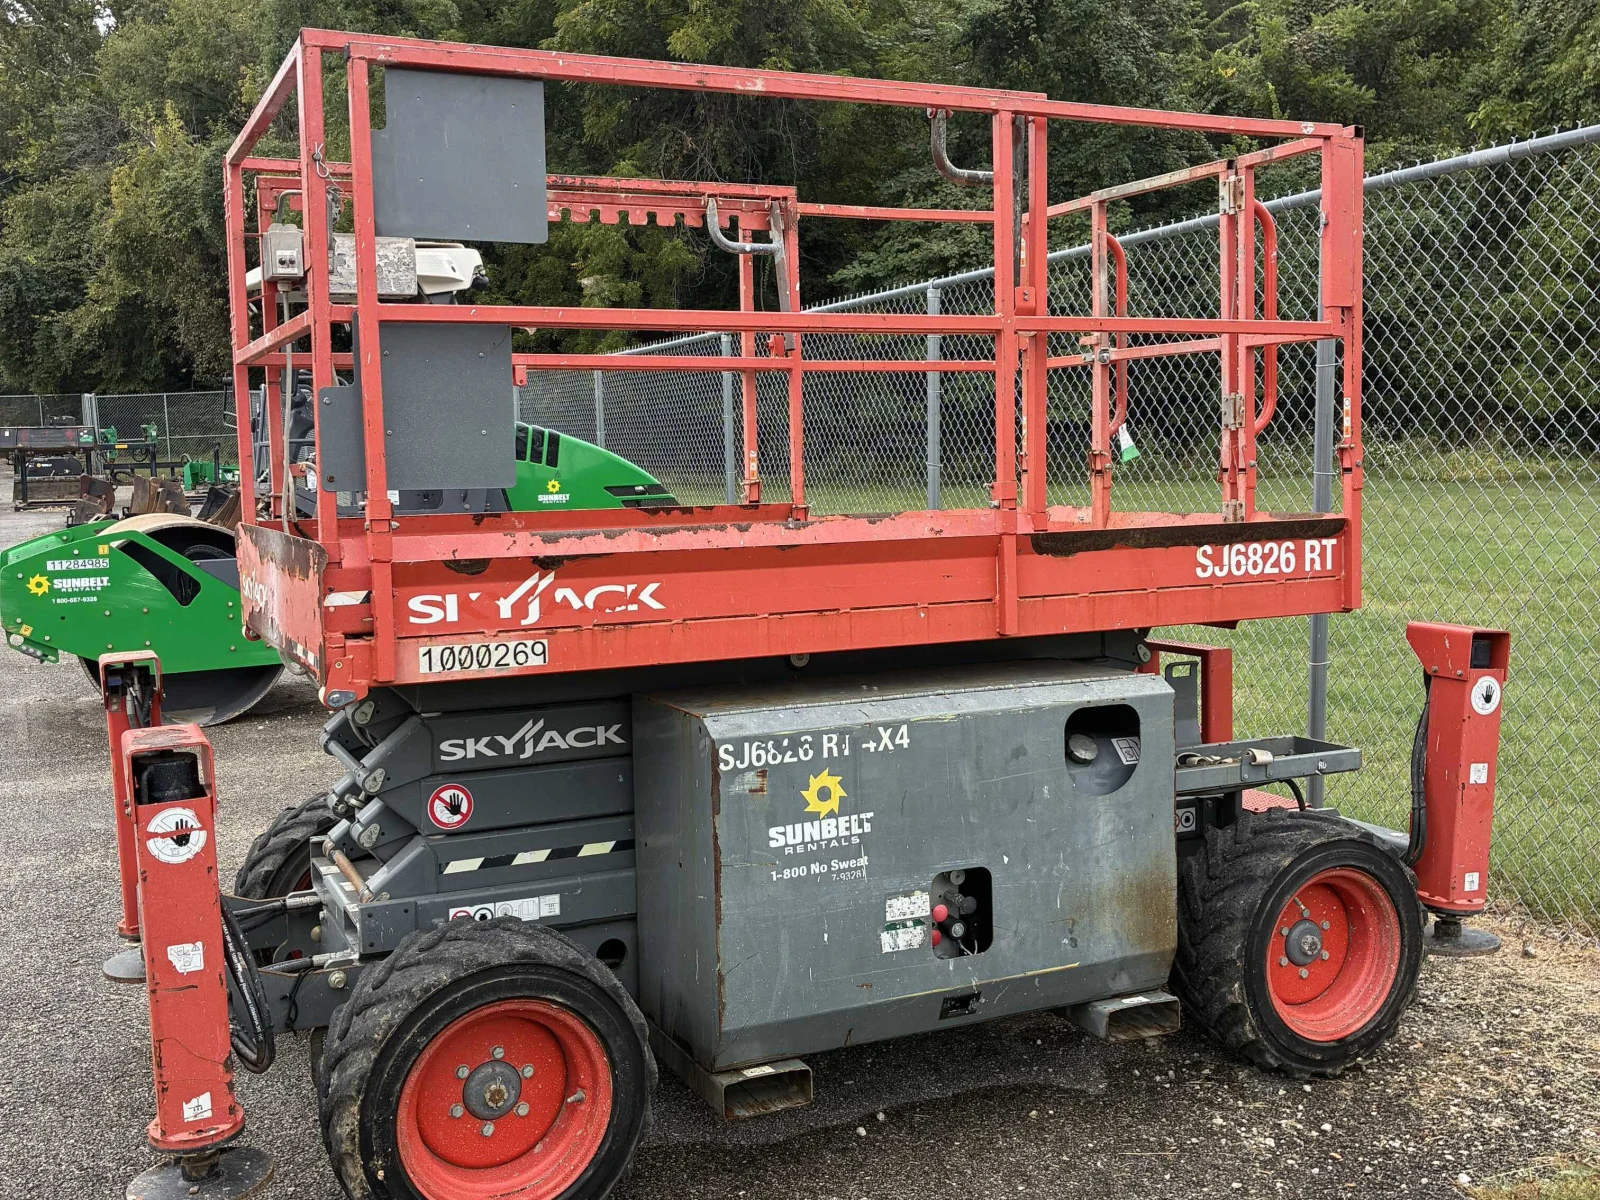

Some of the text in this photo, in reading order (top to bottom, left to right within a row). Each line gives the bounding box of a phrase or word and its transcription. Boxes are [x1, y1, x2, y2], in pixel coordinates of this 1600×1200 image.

[51, 559, 108, 570] 11284985
[1196, 538, 1337, 578] SJ6826 RT
[53, 577, 109, 588] SUNBELT
[422, 642, 547, 672] 1000269
[440, 718, 626, 760] SKYJACK
[768, 812, 875, 848] SUNBELT
[785, 836, 860, 856] RENTALS
[771, 856, 868, 881] 1-800 No Sweat
